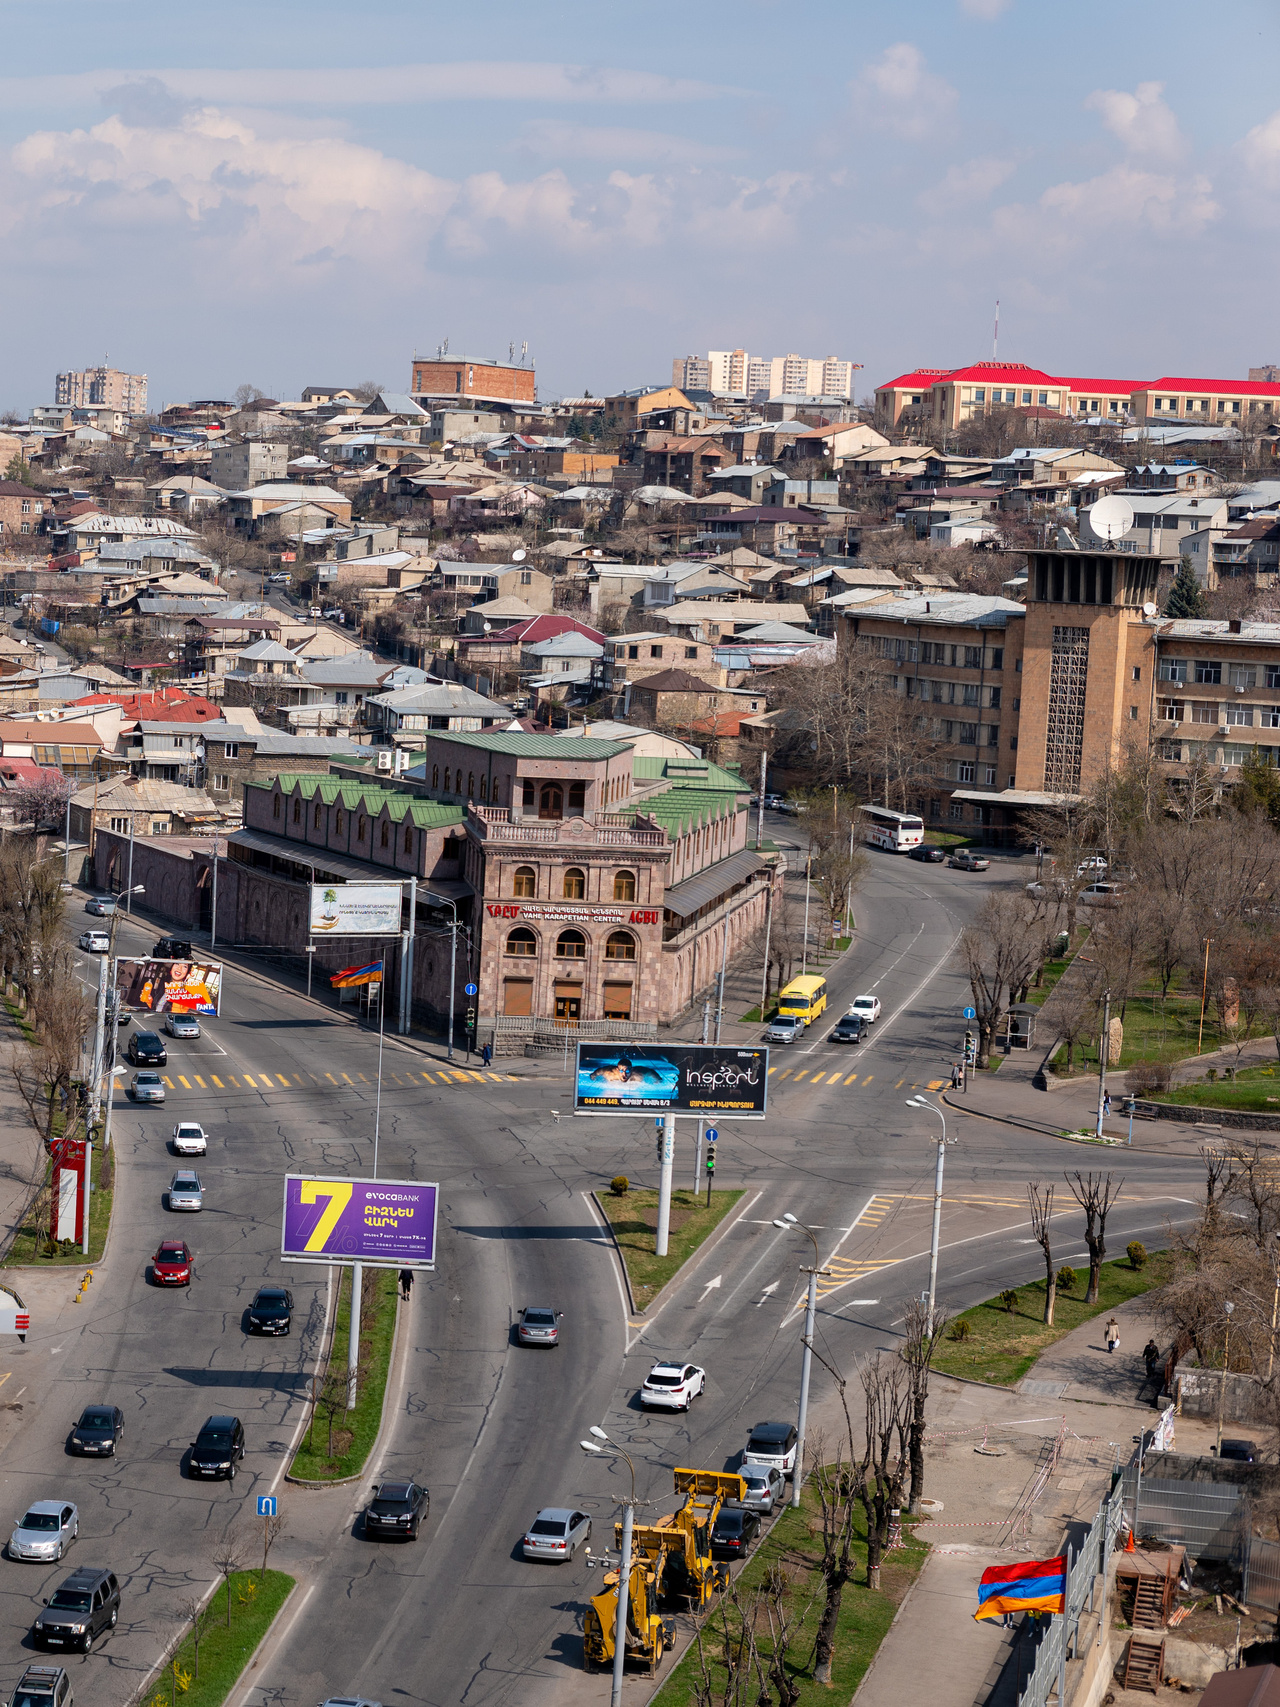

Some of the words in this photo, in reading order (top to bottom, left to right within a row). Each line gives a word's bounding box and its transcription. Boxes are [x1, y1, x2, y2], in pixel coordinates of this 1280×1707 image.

[487, 904, 520, 919] ՀԲԸՄ
[543, 906, 588, 914] ԿԱՐԱՊԵՏՅԱՆ
[544, 913, 589, 922] KARAPETIAN
[593, 915, 622, 923] CENTER
[628, 910, 659, 924] AGBU
[364, 1205, 414, 1217] ԲԻԶՆԵՍ
[364, 1216, 398, 1228] ՎԱՐԿ
